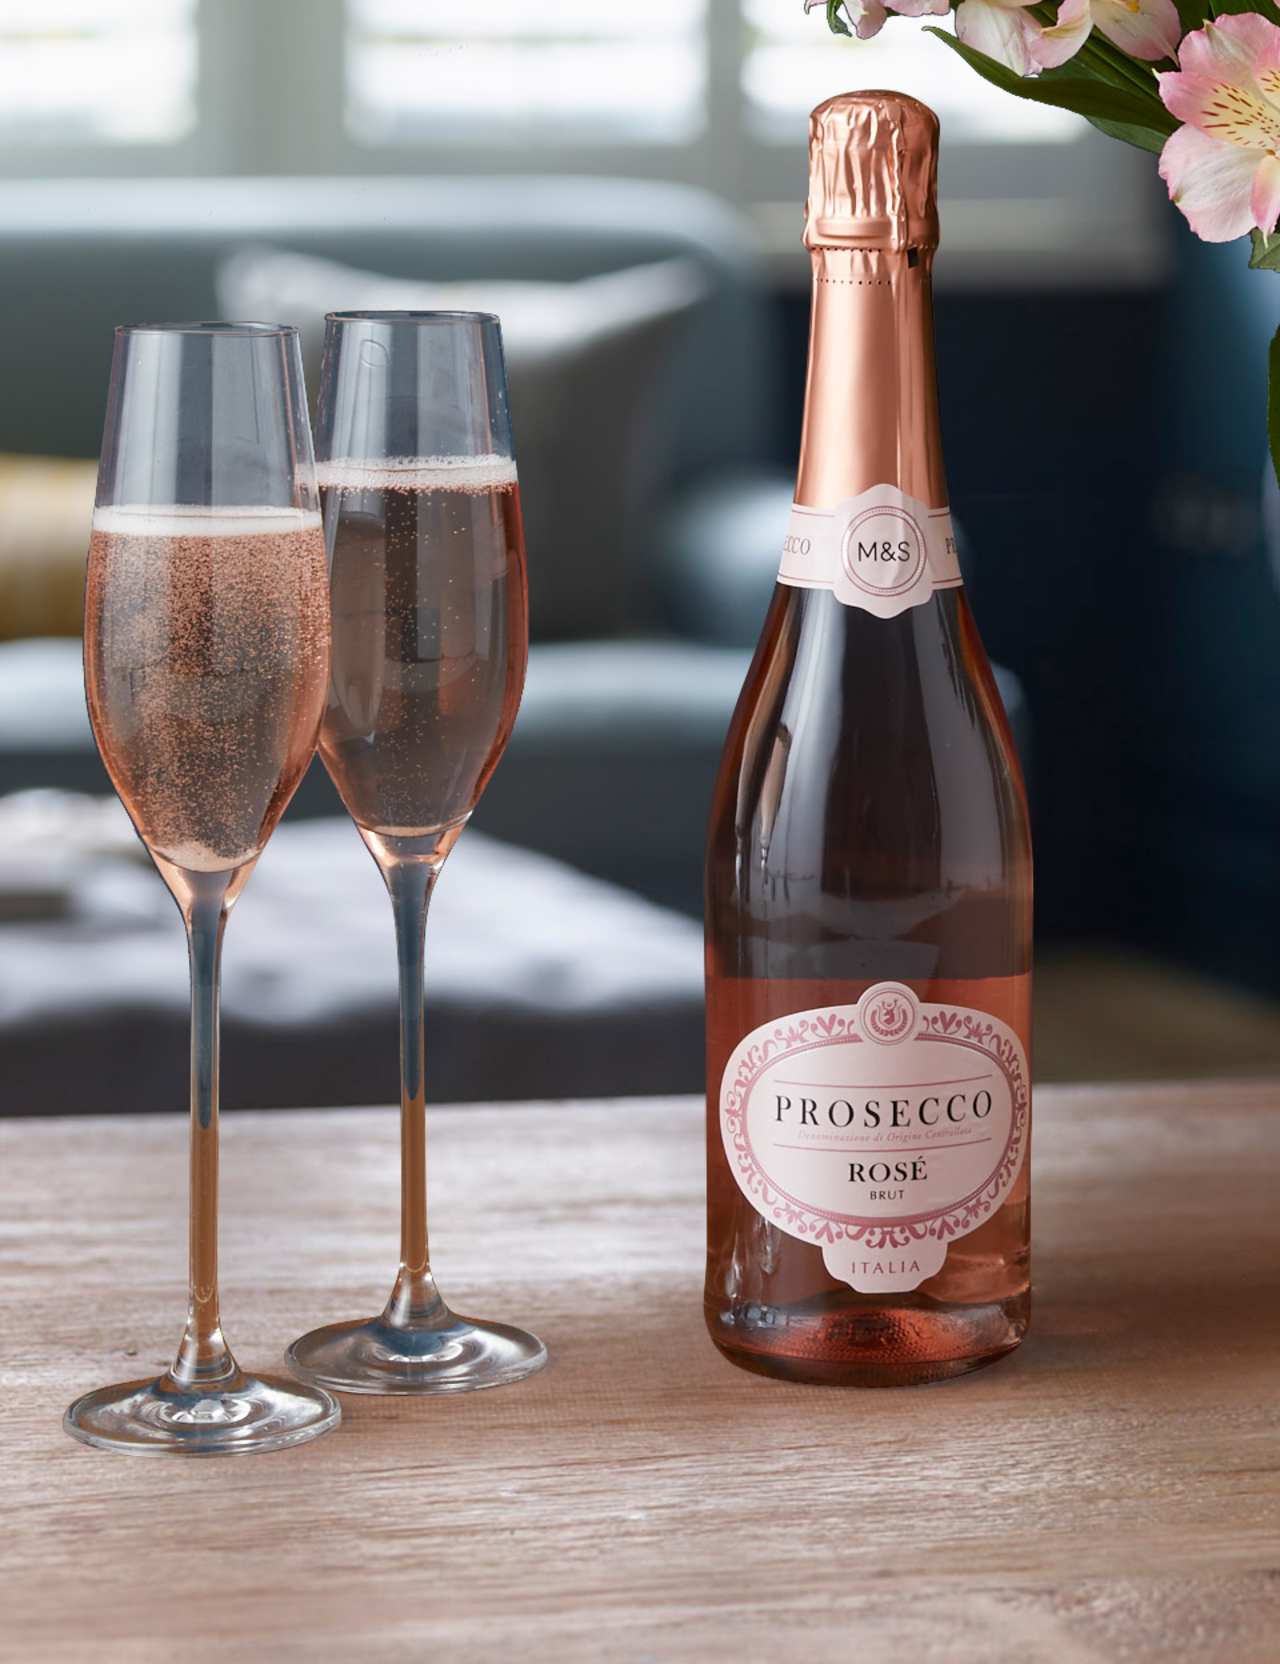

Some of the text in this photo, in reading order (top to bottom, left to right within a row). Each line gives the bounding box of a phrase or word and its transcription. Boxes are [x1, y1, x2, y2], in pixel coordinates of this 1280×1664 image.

[857, 540, 911, 563] M&S
[775, 1089, 993, 1128] PROSECCO
[848, 1156, 928, 1183] ROSÉ
[869, 1189, 905, 1201] BRUT
[851, 1259, 921, 1275] ITALIA
